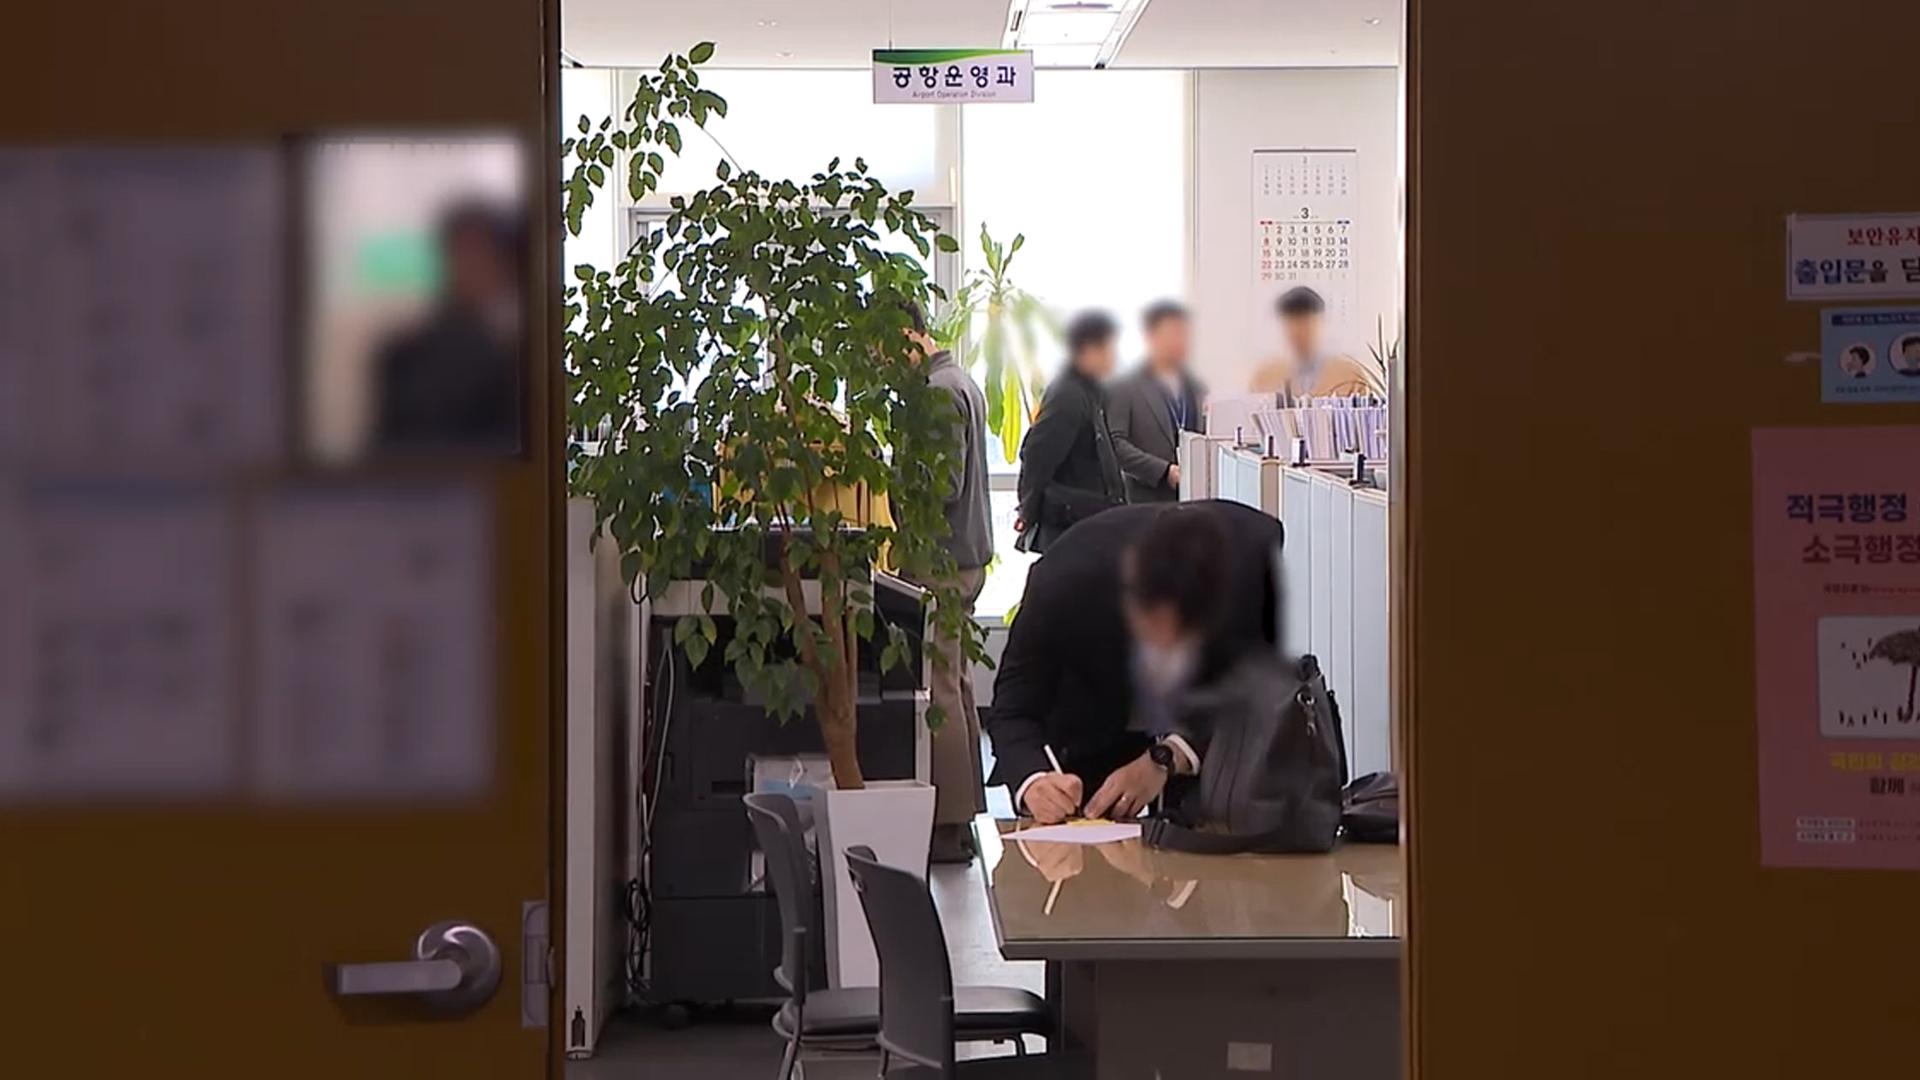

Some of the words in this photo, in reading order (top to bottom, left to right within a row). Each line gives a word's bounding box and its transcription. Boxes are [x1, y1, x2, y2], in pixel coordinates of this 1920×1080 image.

[893, 65, 1016, 88] 공항운영과
[912, 91, 935, 99] Airport
[937, 90, 969, 98] Operation
[1301, 207, 1310, 219] 3
[1288, 237, 1297, 245] 10
[1302, 237, 1309, 245] 11
[1314, 237, 1322, 245] 12
[1326, 237, 1335, 245] 13
[1340, 237, 1348, 245] 14
[1847, 226, 1920, 246] 보안유지
[1263, 249, 1271, 257] 15
[1275, 249, 1284, 257] 16
[1288, 249, 1296, 257] 17
[1301, 249, 1309, 257] 18
[1314, 249, 1322, 257] 19
[1326, 249, 1336, 257] 20
[1339, 249, 1347, 257] 21
[1262, 260, 1271, 269] 22
[1275, 260, 1284, 269] 23
[1288, 260, 1297, 269] 24
[1300, 260, 1310, 269] 25
[1313, 260, 1323, 269] 26
[1326, 260, 1336, 269] 27
[1339, 260, 1348, 269] 28
[1795, 259, 1888, 284] 출입문을
[1787, 494, 1907, 523] 적극행정
[1802, 534, 1920, 564] 소극행정
